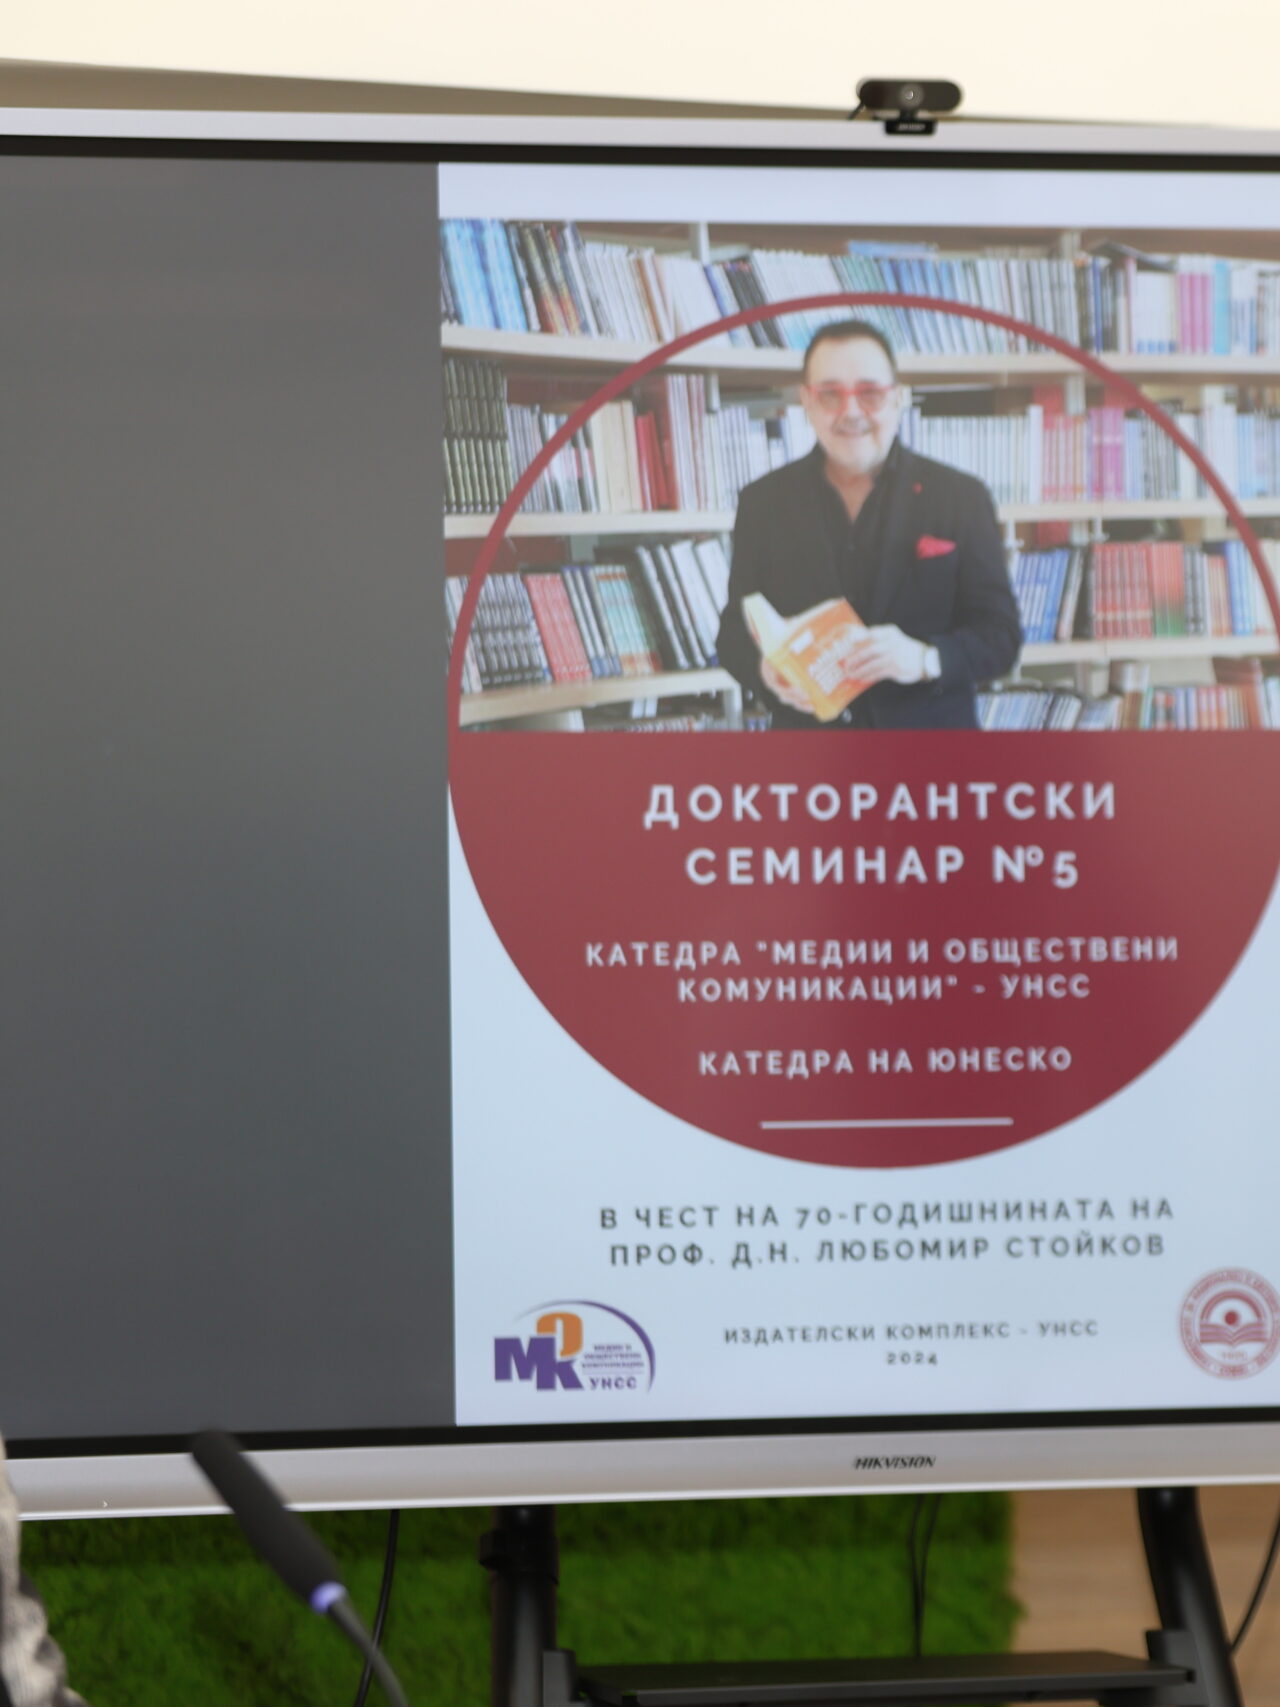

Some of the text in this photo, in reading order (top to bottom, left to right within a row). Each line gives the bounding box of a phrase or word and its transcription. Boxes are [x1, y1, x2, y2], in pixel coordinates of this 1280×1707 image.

[642, 782, 1115, 831] ДОКТОРАНТСКИ
[685, 846, 964, 886] СЕМИНАР
[585, 936, 1178, 971] КАТЕДРА "МЕДИИ И ОБЩЕСТВЕНИ
[677, 974, 957, 1004] КОМУНИКАЦИИ"
[1001, 973, 1090, 999] УНСС
[698, 1045, 1072, 1080] КАТЕДРА НА ЮНЕСКО
[599, 1197, 1174, 1231] В ЧЕСТ НА 70-ГОДИШНИНАТА НА
[610, 1242, 715, 1267] ПРОФ.
[816, 1237, 990, 1263] ЛЮБОМИР
[1004, 1230, 1165, 1259] СТОЙКОВ
[723, 1325, 876, 1346] ИЗДАТЕЛСКИ
[885, 1321, 1011, 1341] КОМПЛЕКС
[1038, 1318, 1100, 1338] УНСС
[886, 1350, 940, 1366] 2024
[589, 1376, 637, 1390] УНСС
[855, 1456, 936, 1469] HIKVISION
